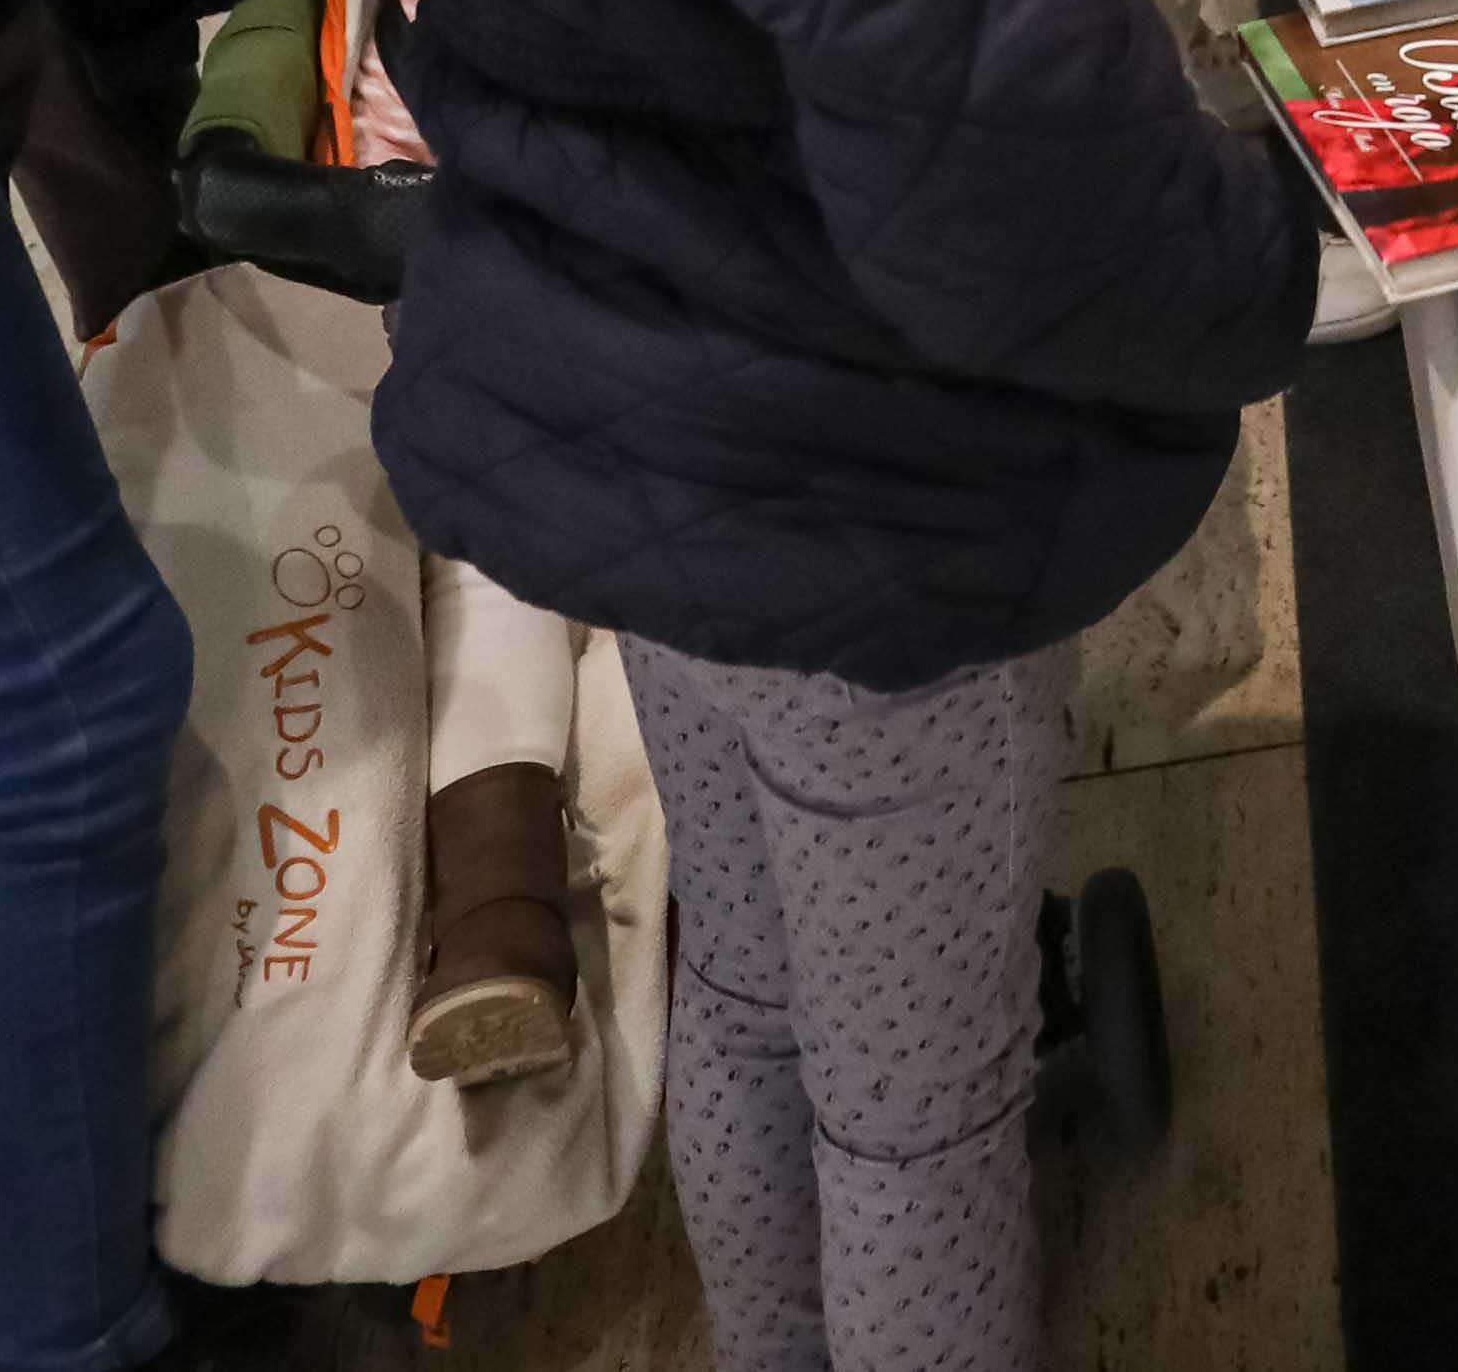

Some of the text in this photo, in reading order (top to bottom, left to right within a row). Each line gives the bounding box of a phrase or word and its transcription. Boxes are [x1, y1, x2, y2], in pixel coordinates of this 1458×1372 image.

[1367, 72, 1396, 92] en
[1313, 93, 1452, 151] rojo
[246, 613, 341, 984] KIDS ZONE
